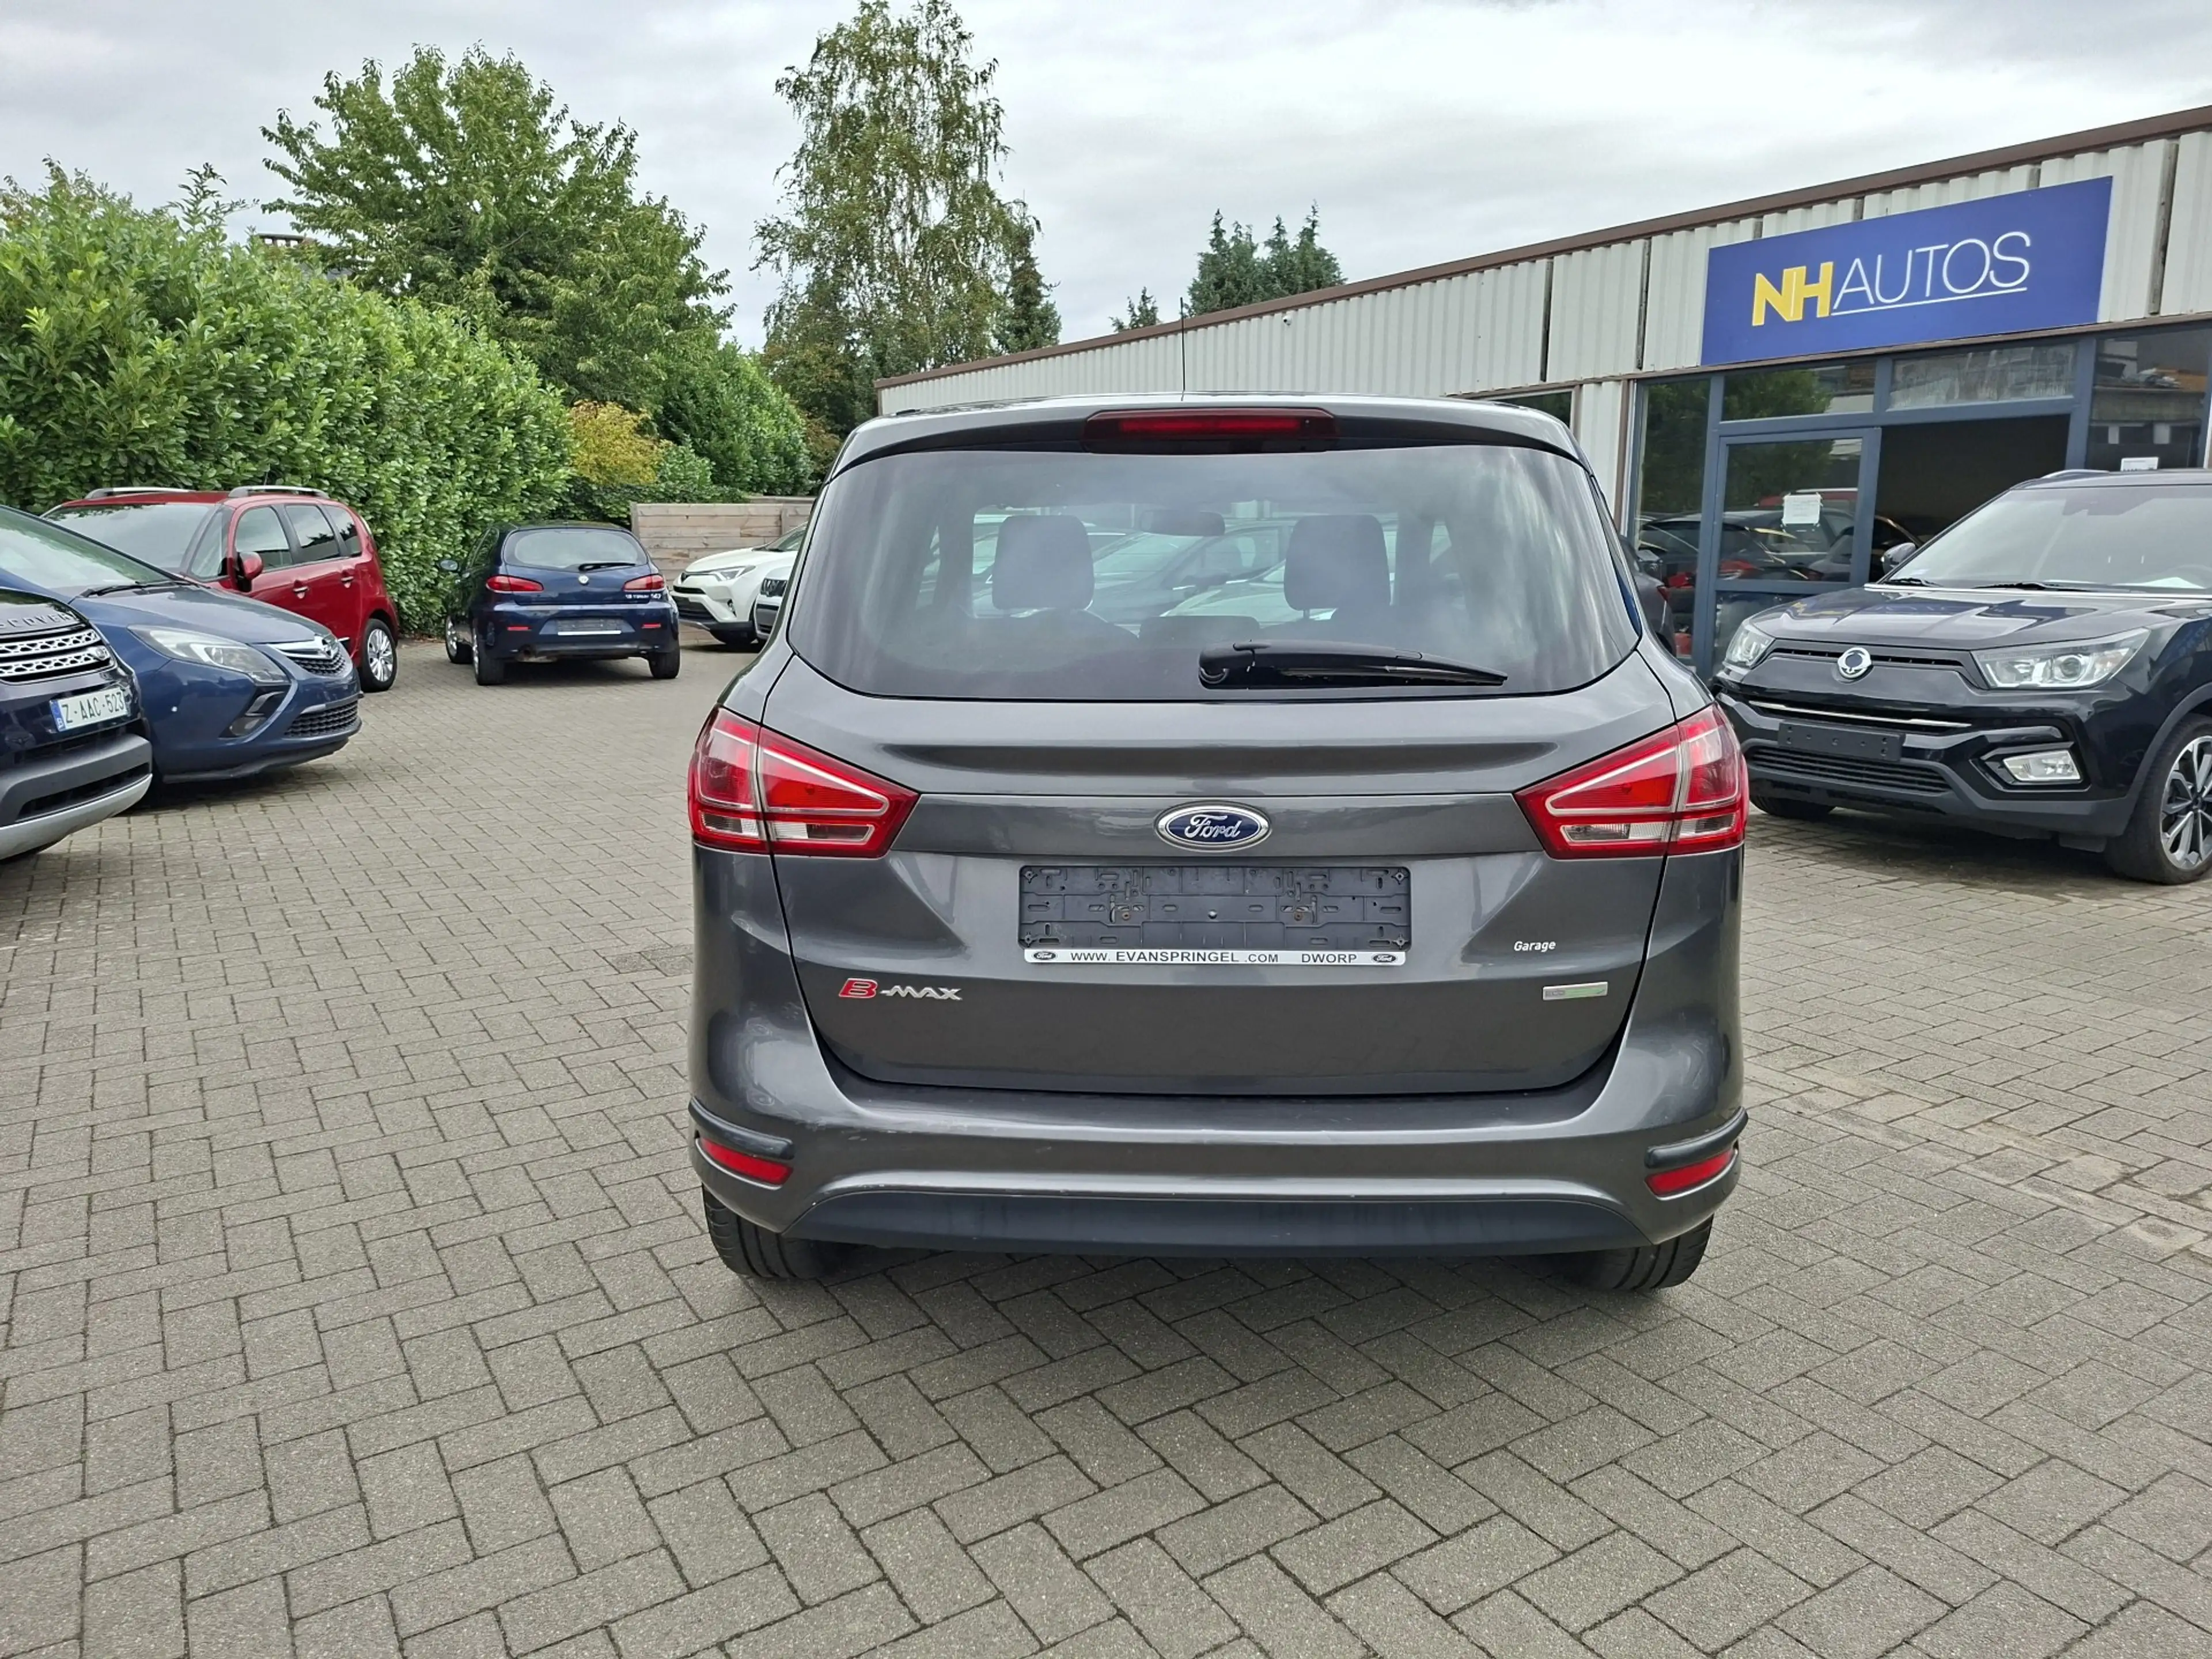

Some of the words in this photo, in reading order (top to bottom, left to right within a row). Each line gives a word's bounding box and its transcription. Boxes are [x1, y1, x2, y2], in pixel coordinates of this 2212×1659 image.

[1184, 814, 1243, 838] Ford
[1514, 941, 1556, 953] Garage
[1116, 951, 1239, 963] EVANSPRINGEL
[1244, 953, 1279, 963] .COM
[1301, 953, 1357, 964] DWORP
